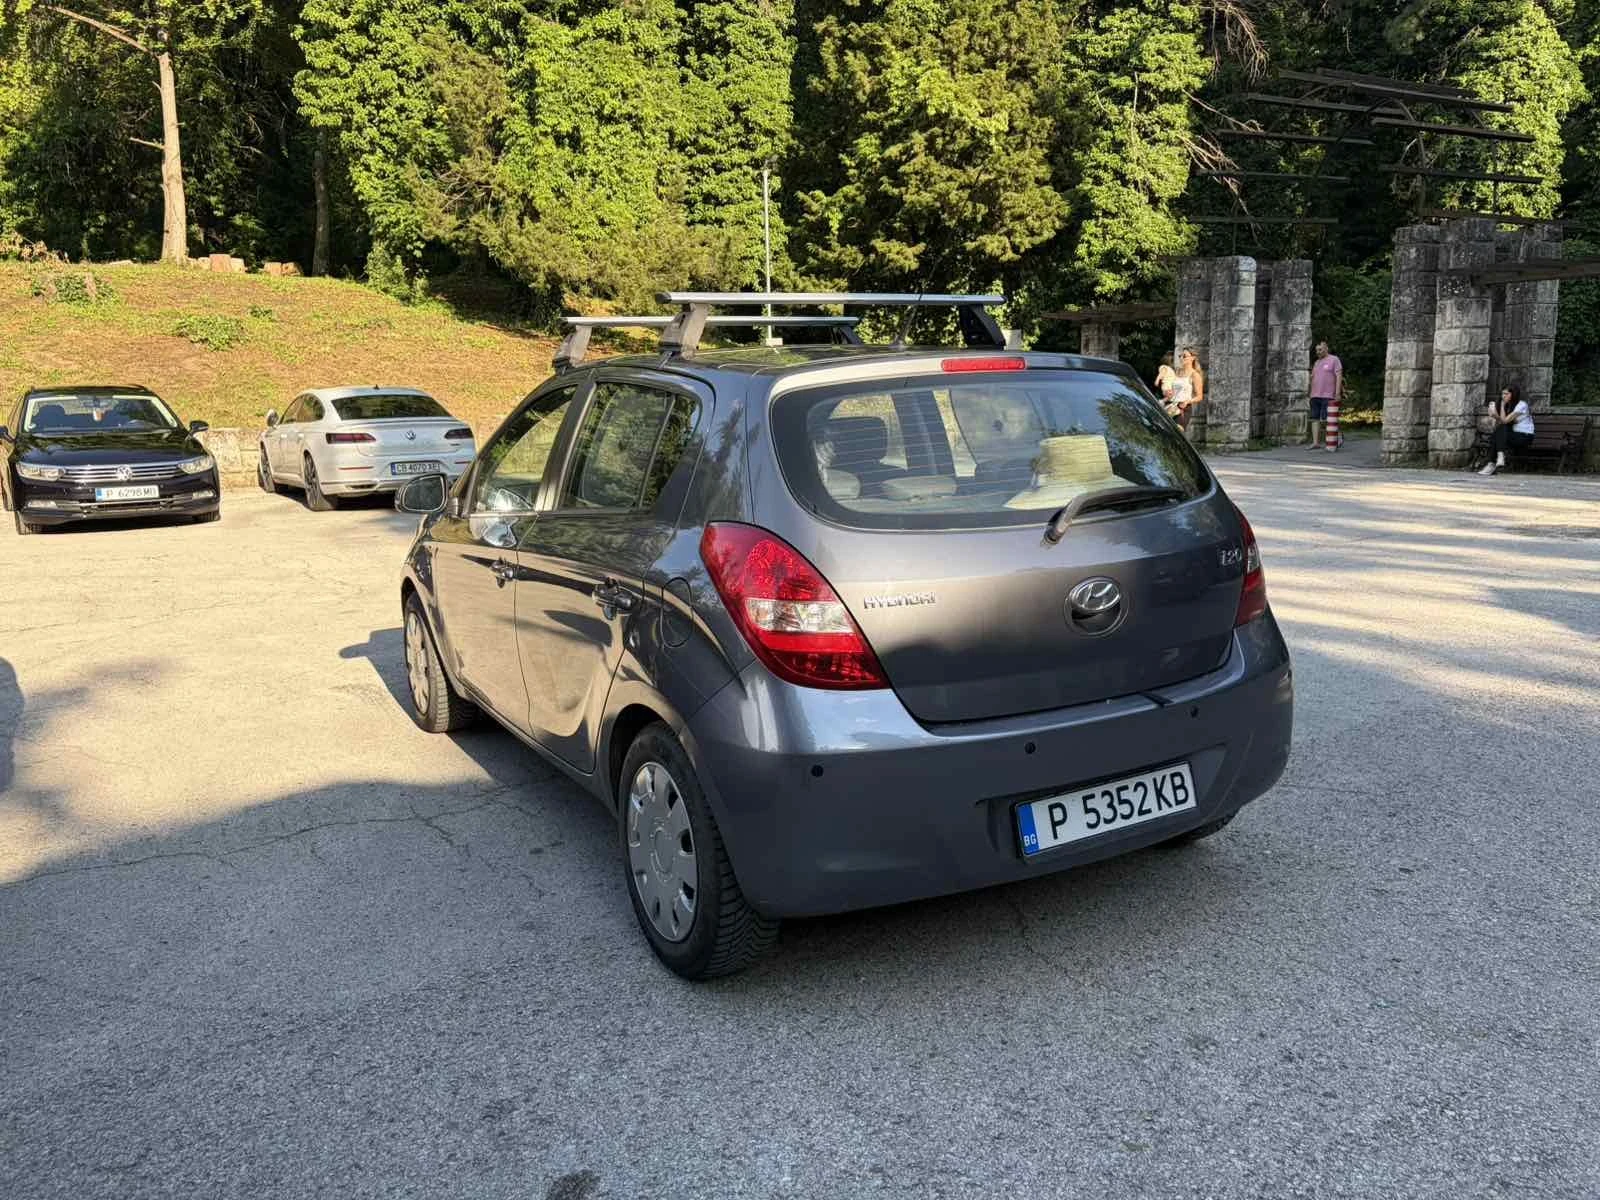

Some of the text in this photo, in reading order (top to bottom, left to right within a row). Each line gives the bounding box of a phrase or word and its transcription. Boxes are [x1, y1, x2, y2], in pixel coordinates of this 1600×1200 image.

[864, 592, 936, 609] HYUNDAI
[1048, 802, 1068, 840] P
[1023, 833, 1037, 847] BG
